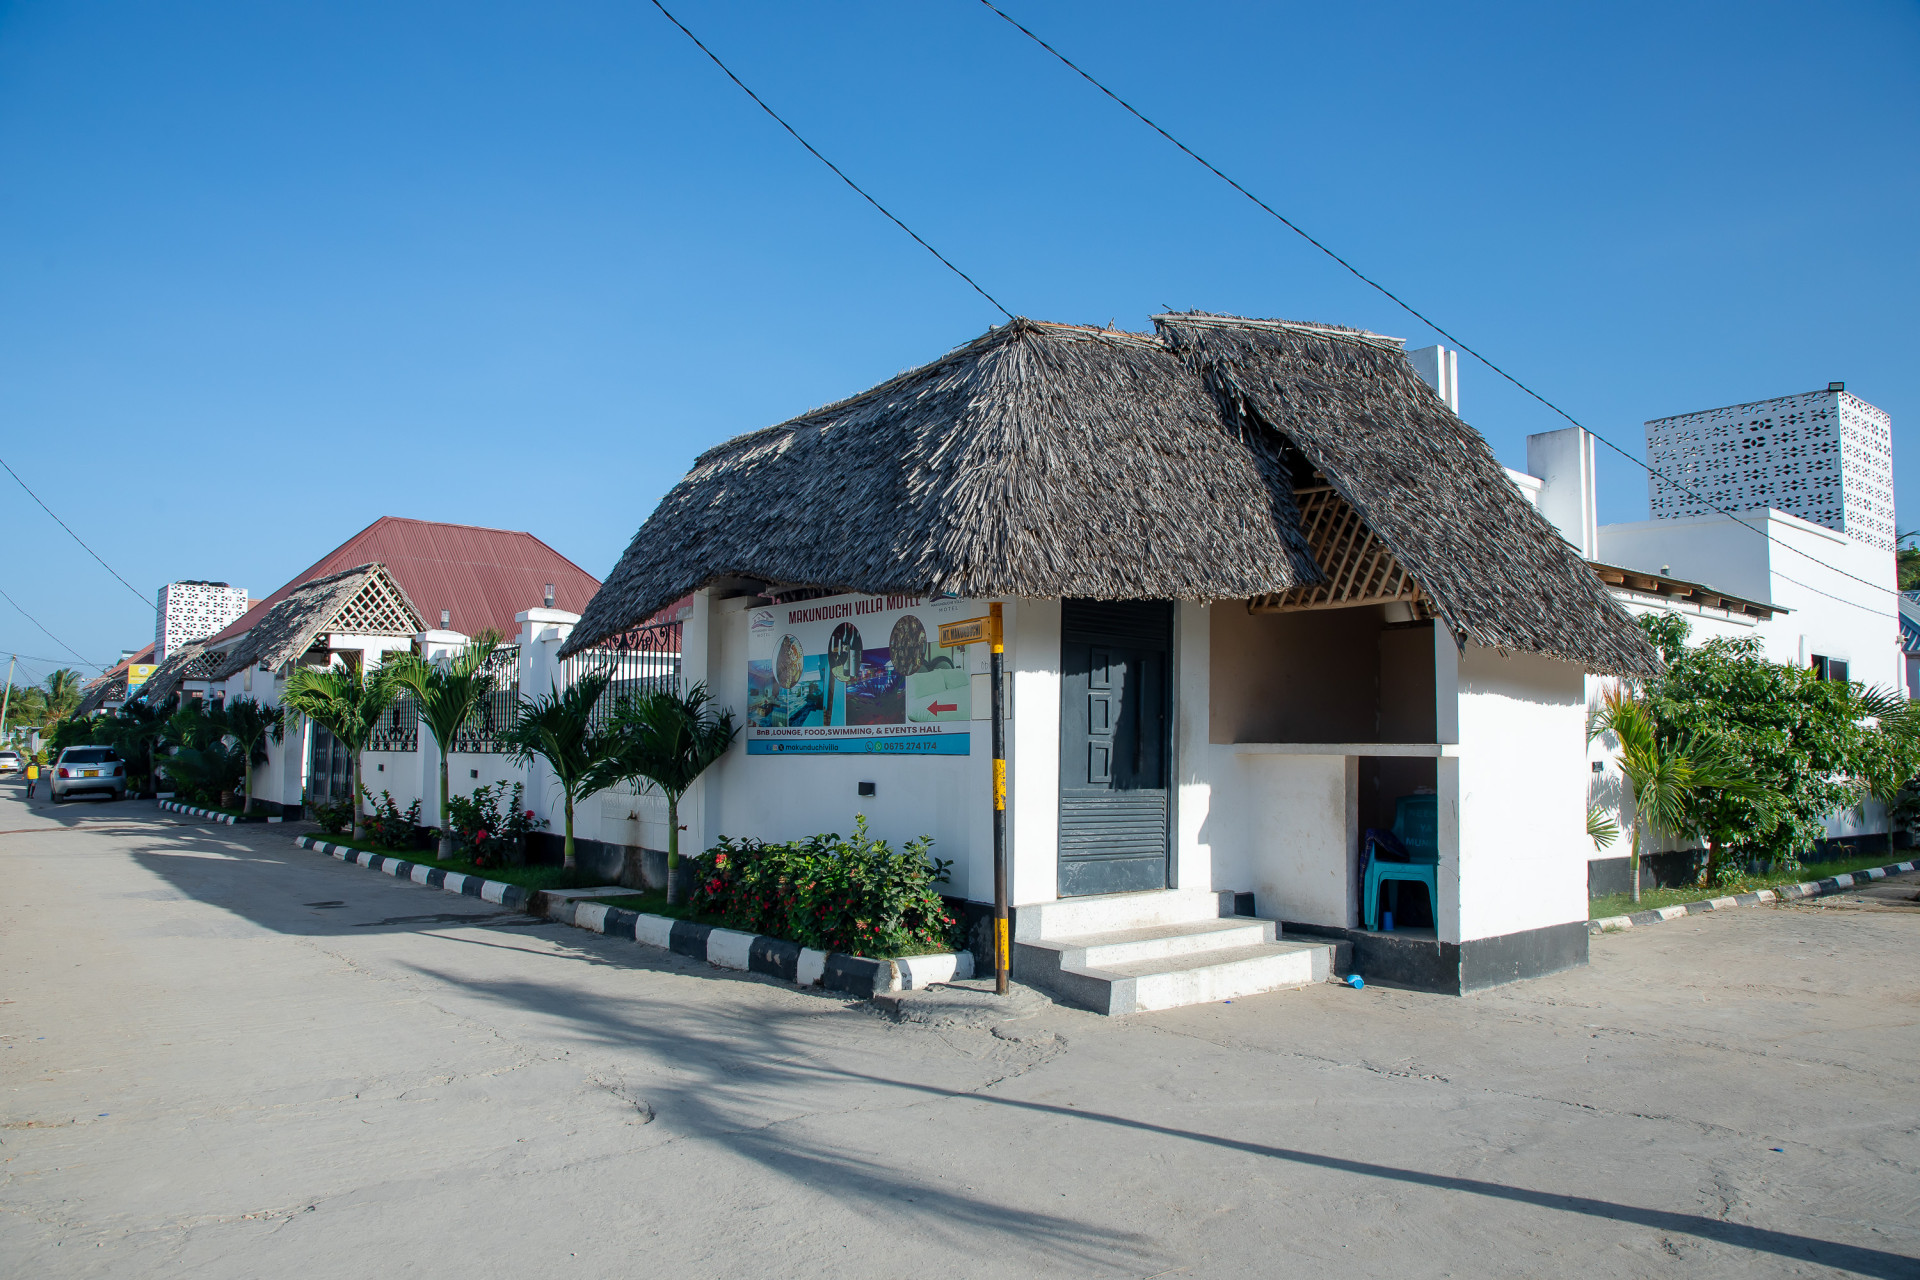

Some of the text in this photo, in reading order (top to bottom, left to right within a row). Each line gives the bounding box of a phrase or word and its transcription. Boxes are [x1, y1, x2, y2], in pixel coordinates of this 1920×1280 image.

[789, 603, 852, 624] MAKUNDUCHI
[855, 598, 883, 615] VILLA
[906, 742, 921, 750] 274
[923, 742, 936, 750] 174
